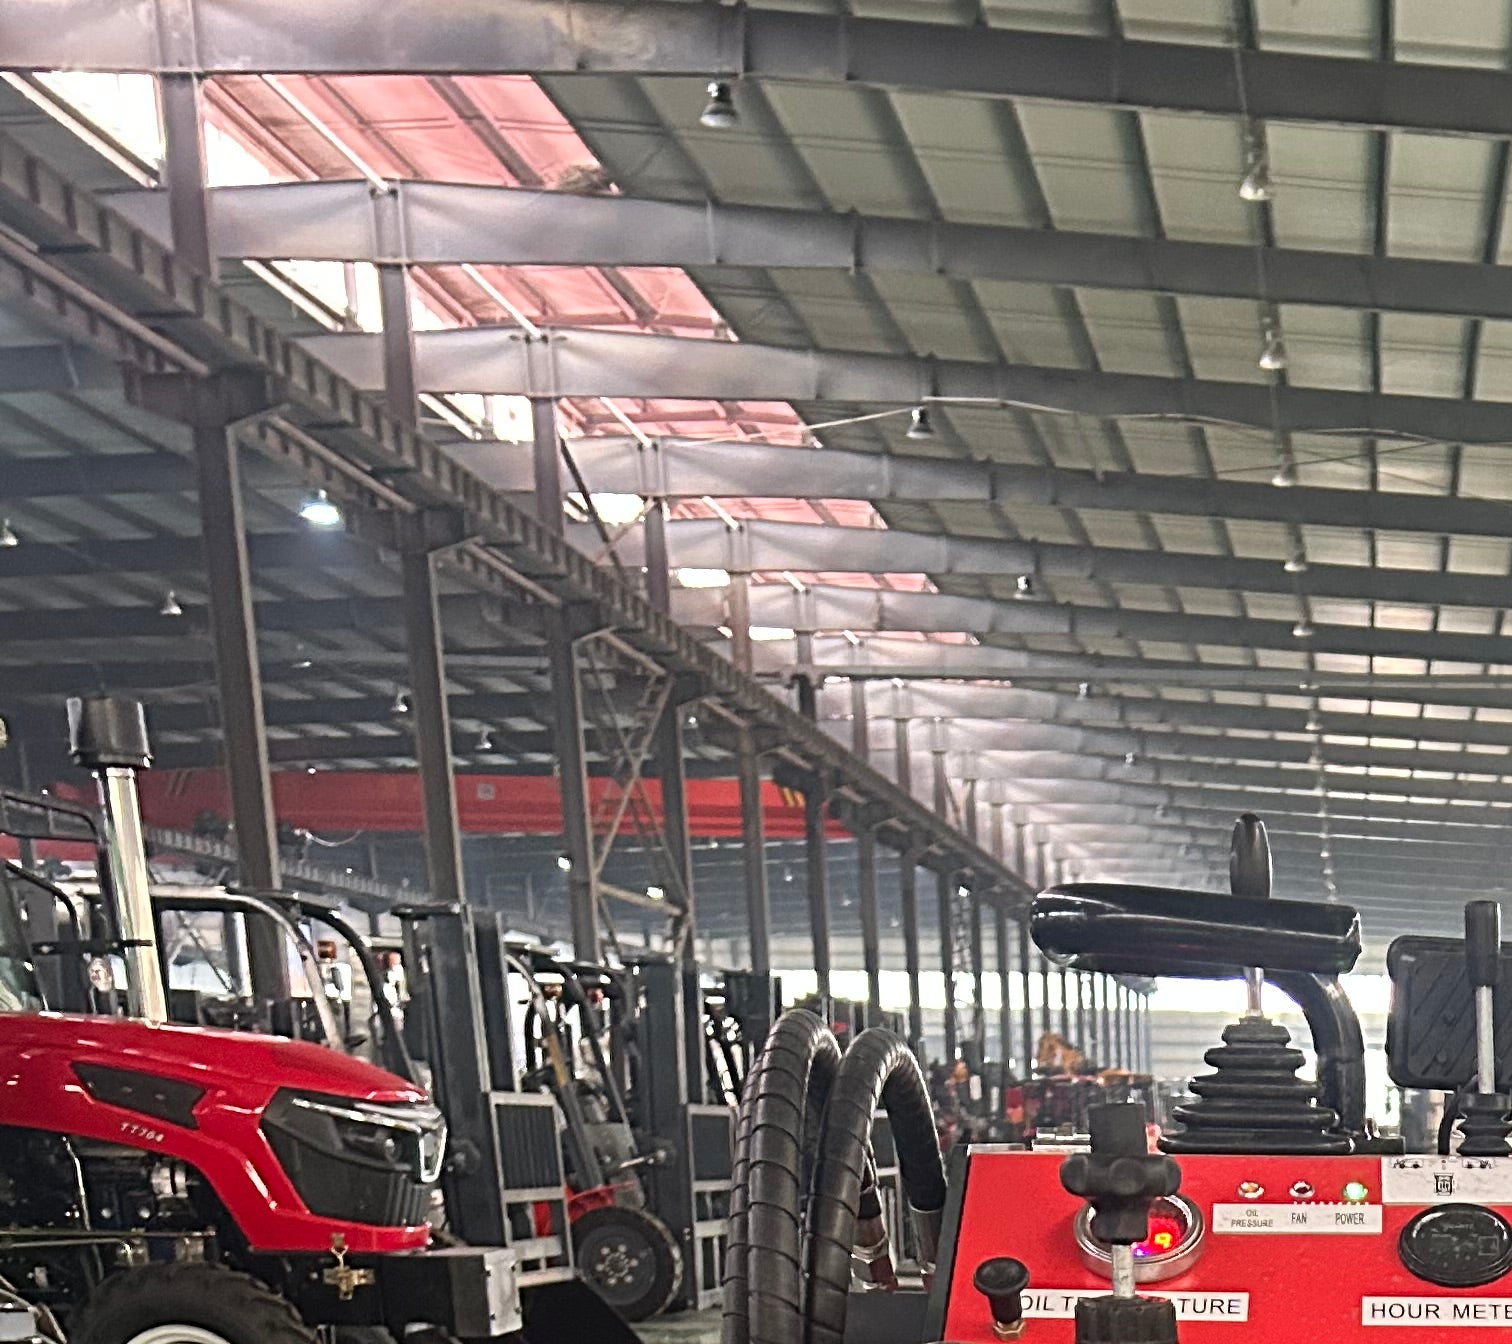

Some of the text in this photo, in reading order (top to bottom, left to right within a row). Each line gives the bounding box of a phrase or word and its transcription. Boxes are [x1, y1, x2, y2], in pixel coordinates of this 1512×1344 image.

[1245, 1209, 1258, 1217] OIL
[1291, 1212, 1307, 1225] FAN
[1335, 1212, 1365, 1225] POWER
[1231, 1219, 1273, 1228] PRESSURE
[1371, 1303, 1440, 1319] HOUR
